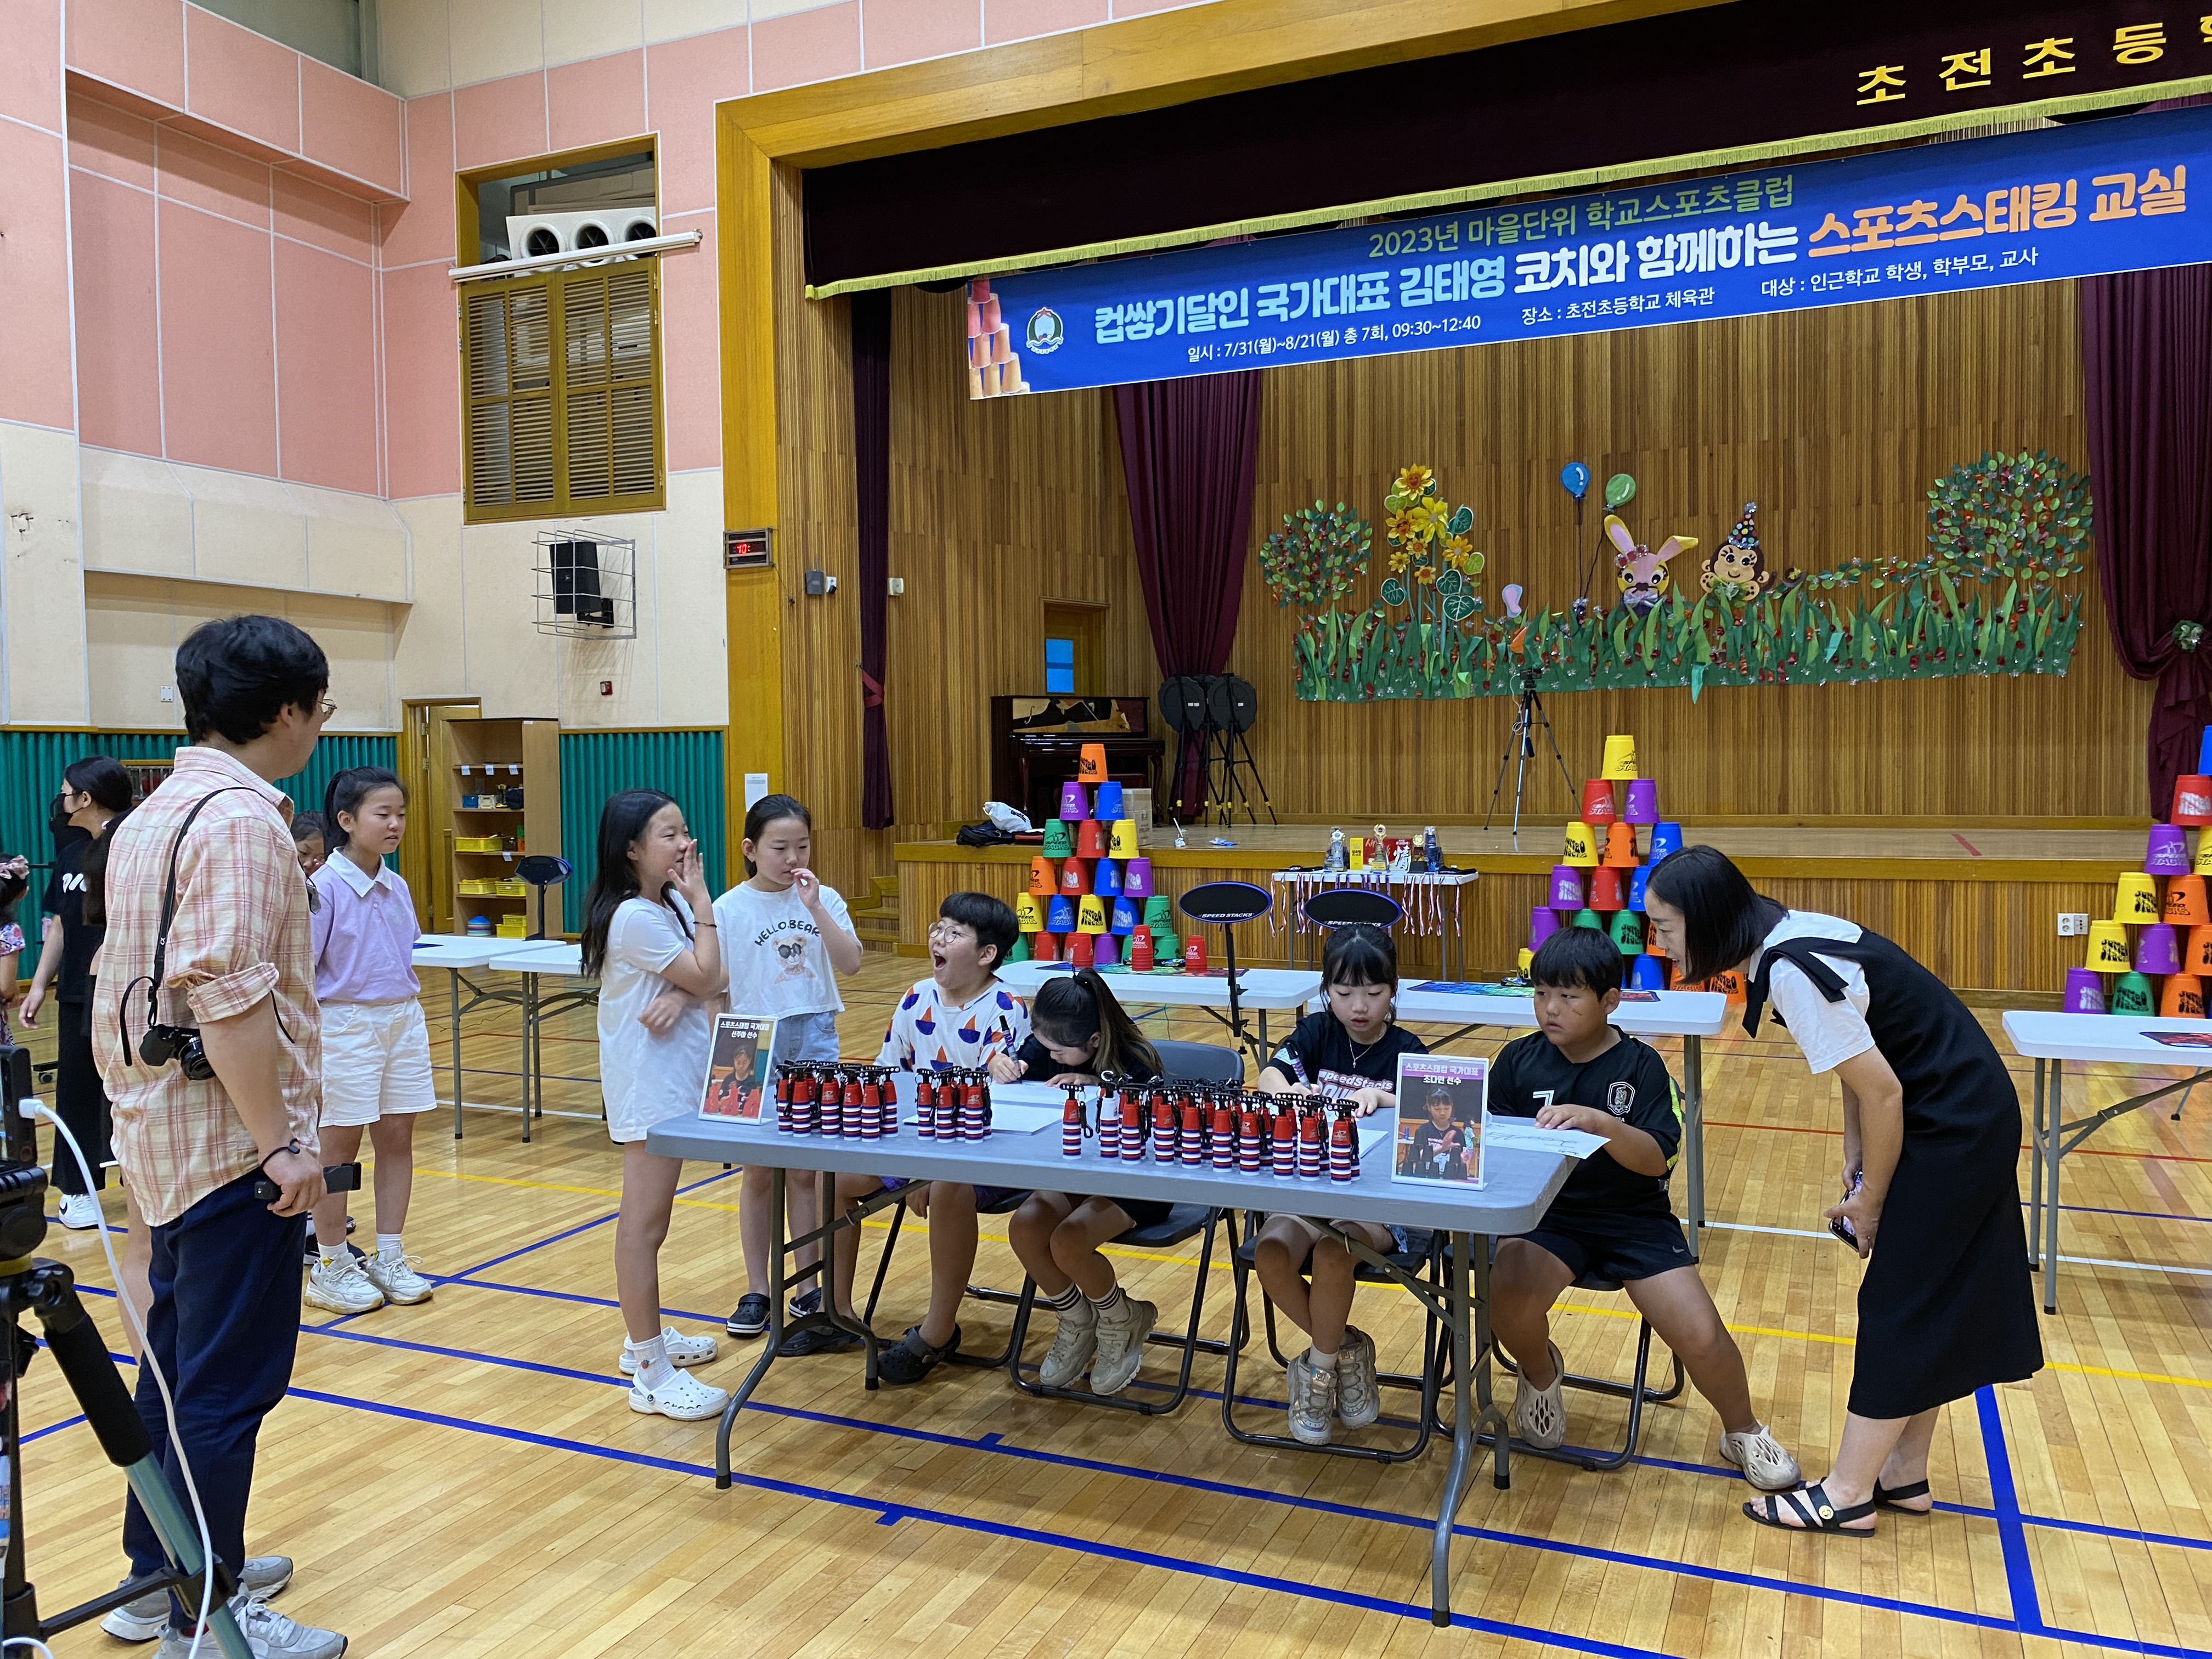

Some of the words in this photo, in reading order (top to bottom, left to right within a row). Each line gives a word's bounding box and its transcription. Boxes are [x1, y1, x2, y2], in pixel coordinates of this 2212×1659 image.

[1369, 227, 1459, 258] 2023년
[1469, 206, 1576, 245] 마을단위
[1587, 174, 1793, 233] 학교스포츠클럽
[1095, 289, 1249, 344] 컵쌓기달인
[1257, 272, 1390, 321] 국가대표
[1400, 256, 1505, 306] 김태영
[1514, 239, 1630, 294] 코치와
[1637, 221, 1798, 278] 함께하는
[1808, 178, 2076, 258] 스포츠스태킹
[2089, 165, 2187, 222] 교실
[1761, 277, 1796, 297] 대상
[1810, 267, 1880, 292] 인근학교
[1886, 262, 1927, 283] 학생,
[1933, 252, 1994, 277] 학부모,
[1999, 246, 2039, 268] 교사
[1521, 307, 1553, 325] 장소
[1565, 294, 1661, 320] 초전초등학교
[1665, 287, 1714, 309] 체육관
[1187, 346, 1214, 363] 일시
[1224, 330, 1340, 358] 7/31(월)~8/21(월)
[1344, 328, 1357, 346] 총
[1391, 315, 1481, 338] 09:30~12:40
[1446, 1076, 1462, 1086] 선수
